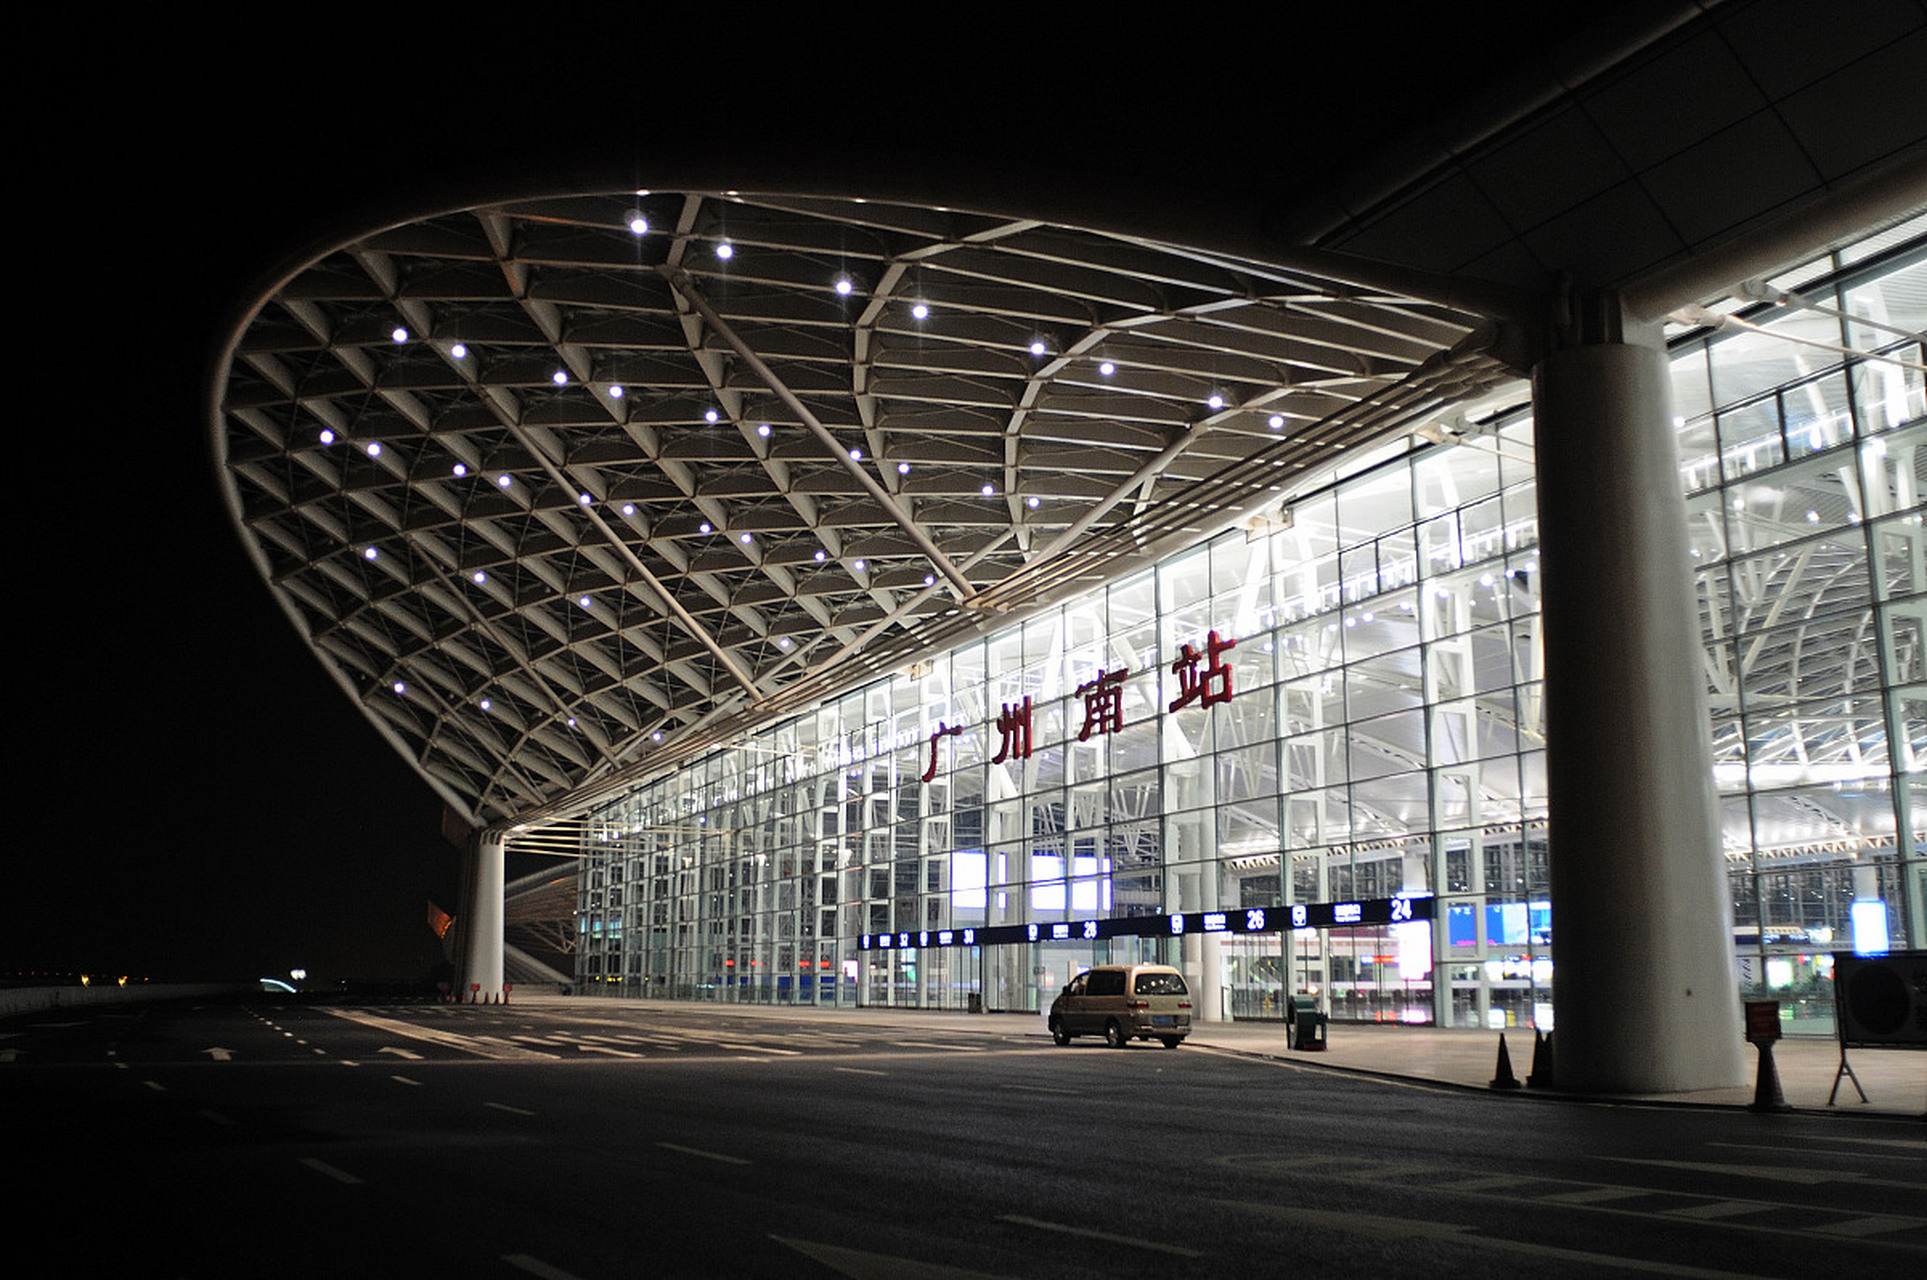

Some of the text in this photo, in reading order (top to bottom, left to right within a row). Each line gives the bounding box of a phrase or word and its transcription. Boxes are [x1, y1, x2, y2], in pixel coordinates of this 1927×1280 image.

[922, 630, 1236, 782] 广州南站
[1247, 908, 1265, 930] 26
[1390, 899, 1413, 921] 24
